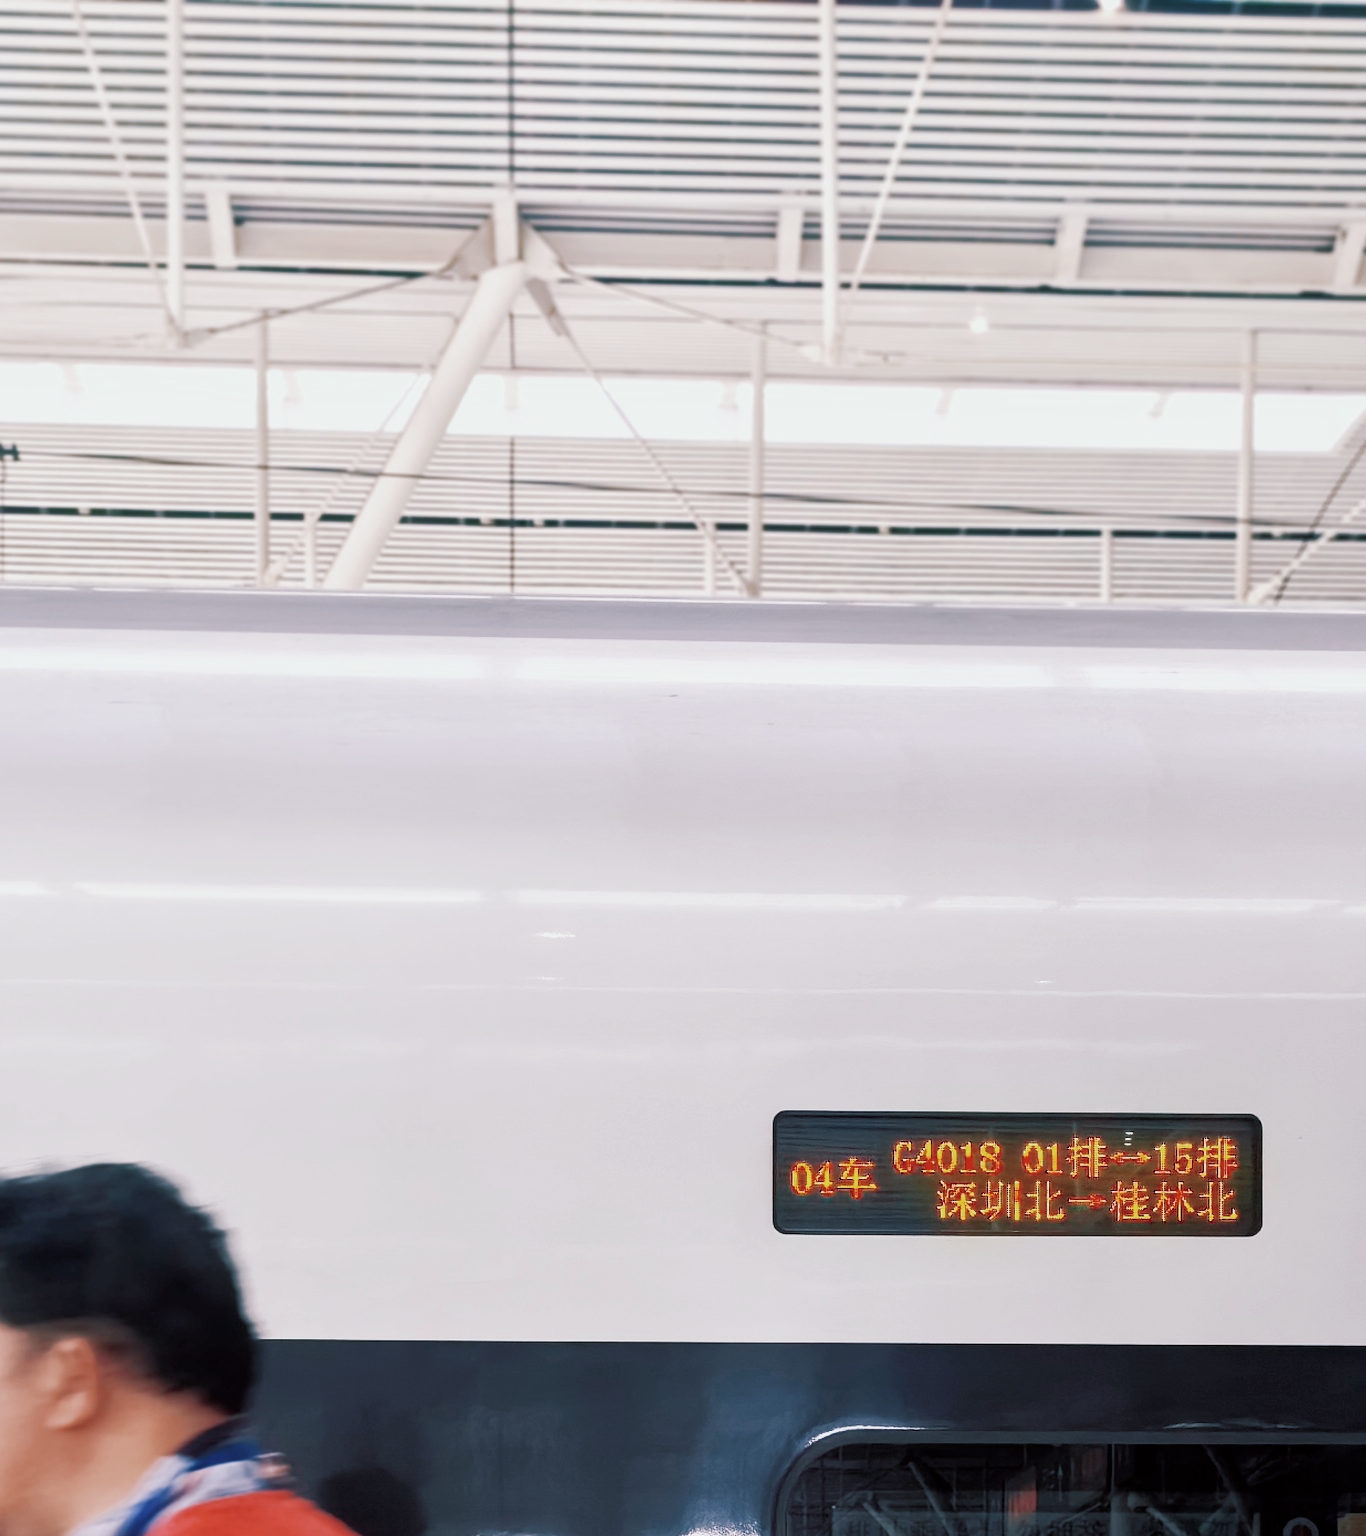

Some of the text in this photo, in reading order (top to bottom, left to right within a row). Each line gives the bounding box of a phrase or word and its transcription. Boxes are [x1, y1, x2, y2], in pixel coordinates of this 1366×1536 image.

[790, 1157, 878, 1200] 04车
[892, 1140, 1002, 1175] G4018
[937, 1180, 1239, 1222] 深圳北 桂林北
